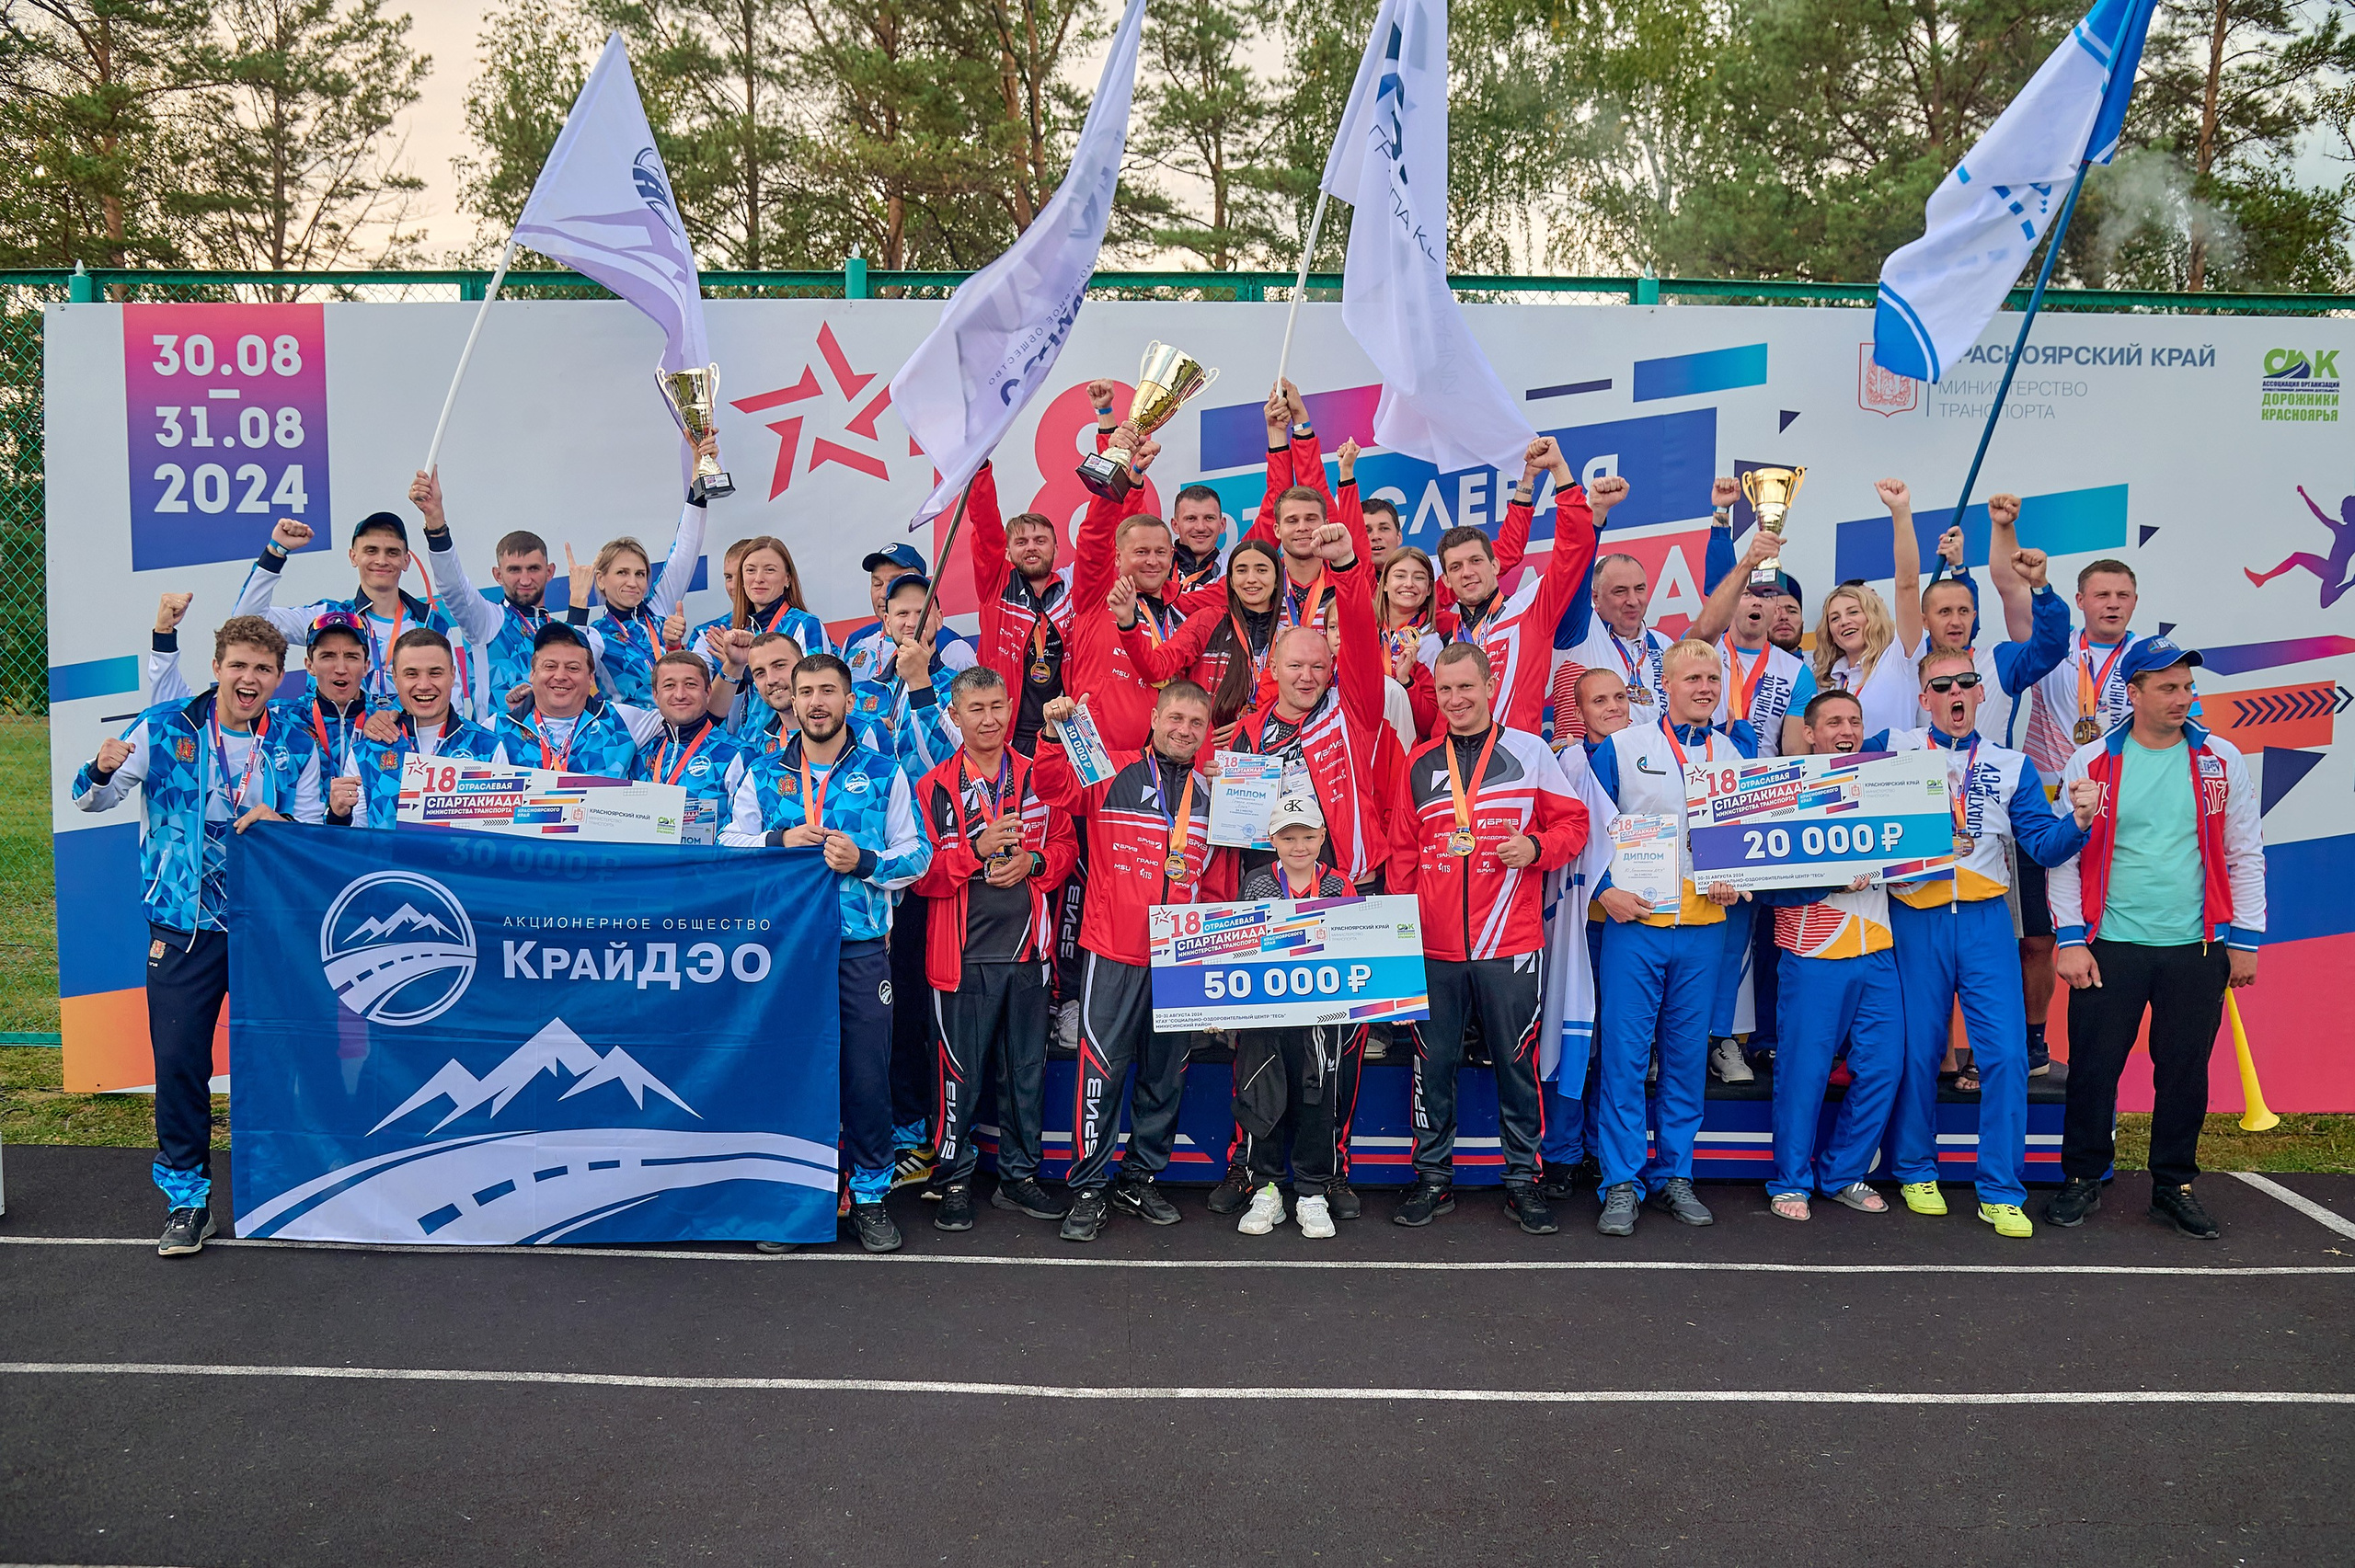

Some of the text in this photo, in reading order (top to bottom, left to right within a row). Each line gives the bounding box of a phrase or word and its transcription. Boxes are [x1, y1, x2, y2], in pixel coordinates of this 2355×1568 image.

[153, 334, 303, 376] 30.08
[1958, 342, 2216, 368] РАСНОЯРСКИЙ КРАЙ
[2262, 393, 2339, 406] ДОРОЖНИКИ
[2261, 408, 2338, 421] КРАСНОЯРЬЯ
[155, 406, 304, 449] 31.08
[154, 463, 308, 514] 2024
[1112, 668, 1131, 679] MSU
[1771, 676, 1791, 718] ДРСУ
[1079, 712, 1088, 721] 18
[1067, 725, 1078, 739] 50
[1073, 740, 1088, 761] 000
[1223, 756, 1238, 768] 18
[423, 766, 513, 793] 18 ОТРАСЛЕВАЯ
[1706, 769, 1790, 798] 18 ОТРАСЛЕВАЯ
[427, 795, 522, 808] СПАРТАКИАДА
[1226, 788, 1267, 798] ДИПЛОМ
[1714, 783, 1802, 811] СПАРТАКИАДА
[1800, 787, 1839, 799] КРАСНОЯРСКОГО
[590, 807, 635, 818] КРАСНОЯРСКИЙ
[1716, 796, 1795, 818] МИНИСТЕРСТВА ТРАНСПОРТА
[1618, 818, 1632, 831] 18
[1621, 826, 1660, 838] СПАРТАКИАДА
[681, 836, 701, 844] ЛОМ
[1120, 844, 1138, 853] БРИЗ
[1137, 836, 1155, 845] БРИЗ
[1188, 838, 1208, 851] БРИЗ
[1743, 829, 1791, 860] 20
[1801, 824, 1874, 856] 000
[1624, 853, 1664, 861] ДИПЛОМ
[1114, 864, 1132, 872] MSU
[502, 916, 771, 932] АКЦИОНЕРНОЕ ОБЩЕСТВО
[1060, 885, 1081, 959] БРИЗ
[1171, 910, 1255, 939] 18 ОТРАСЛЕВАЯ
[1177, 926, 1266, 951] СПАРТАКИАДА
[1263, 931, 1304, 942] КРАСНОЯРСКОГО
[1178, 938, 1259, 957] МИНИСТЕРСТВА ТРАНСПОРТА
[1204, 968, 1252, 1000] 50
[1264, 966, 1340, 997] 000
[1414, 1054, 1430, 1129] БРИЗ
[940, 1080, 958, 1160] БРИЗ
[1084, 1077, 1103, 1160] БРИЗ
